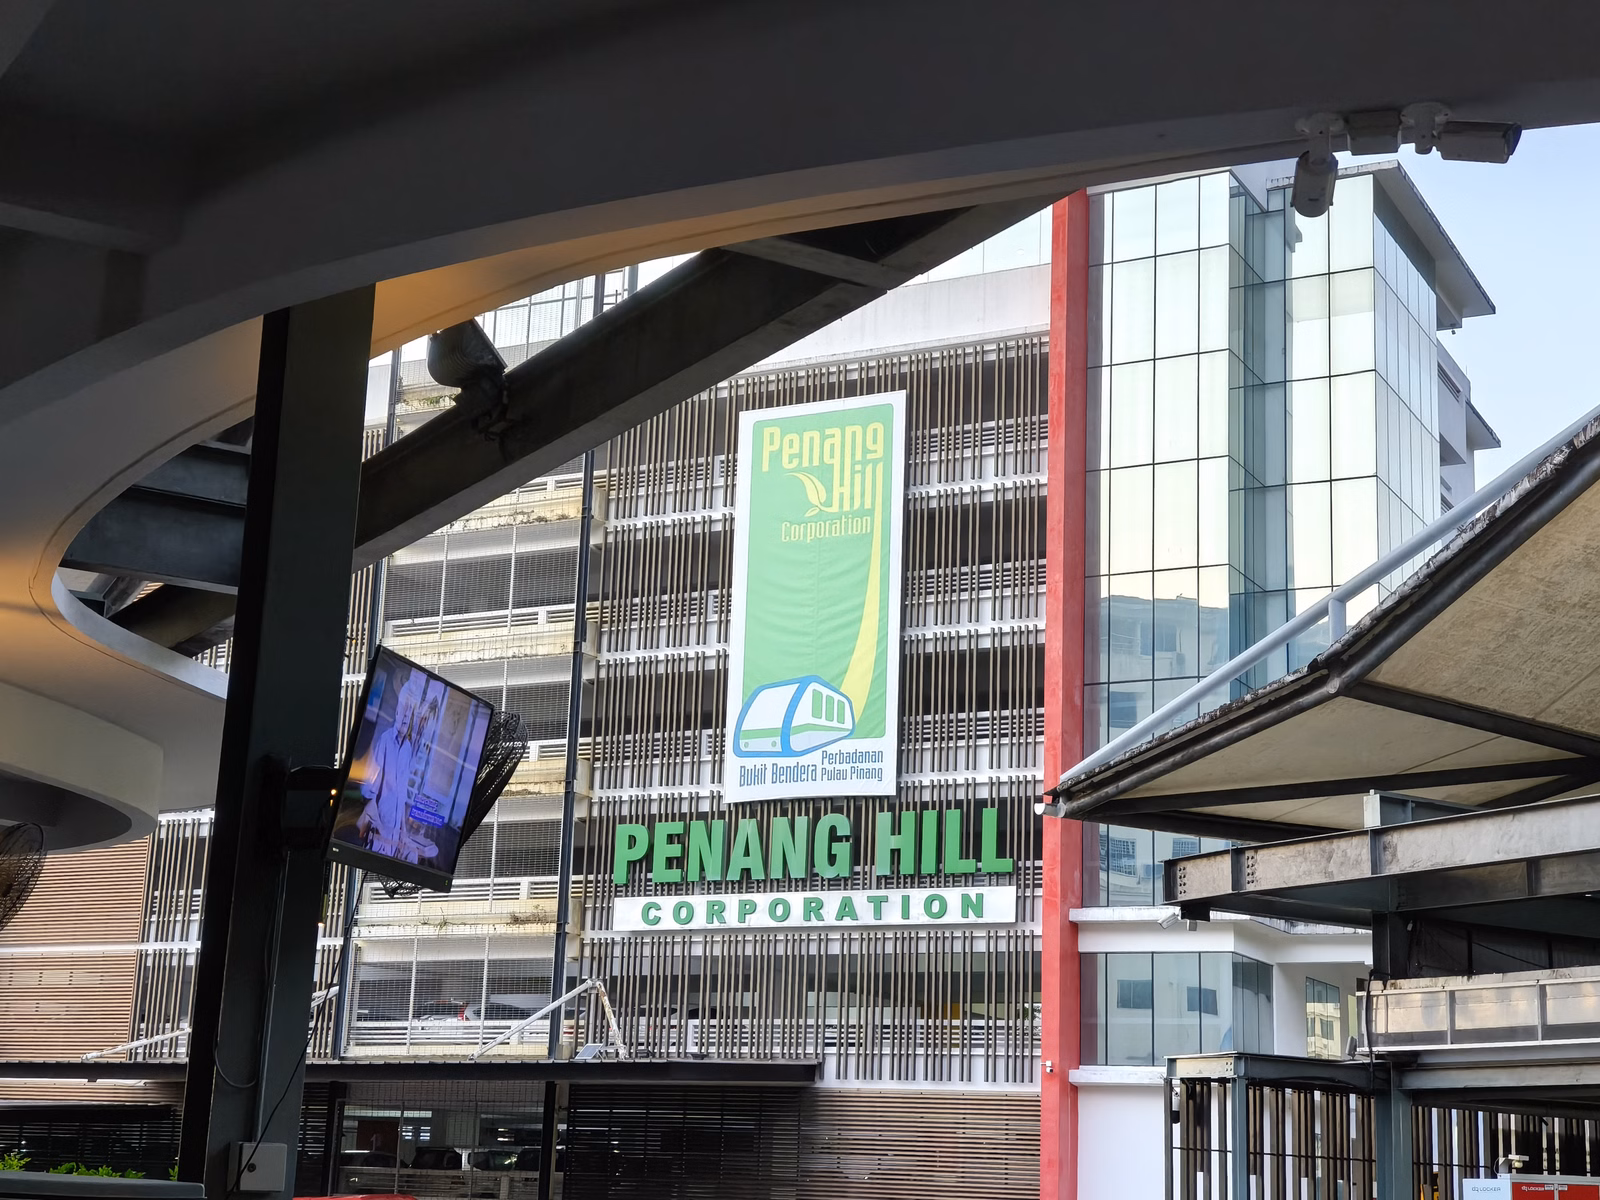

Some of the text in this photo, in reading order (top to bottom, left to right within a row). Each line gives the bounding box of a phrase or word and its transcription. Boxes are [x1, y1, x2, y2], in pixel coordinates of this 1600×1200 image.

[762, 422, 885, 472] Penang
[831, 461, 884, 513] Hill
[781, 515, 871, 543] Corporation
[821, 749, 883, 765] Perbadanan
[739, 762, 817, 787] Bukit Bendera
[820, 766, 883, 782] Pulau Pinang
[613, 808, 1014, 885] PENANG HILL
[641, 893, 984, 926] CORPORATION
